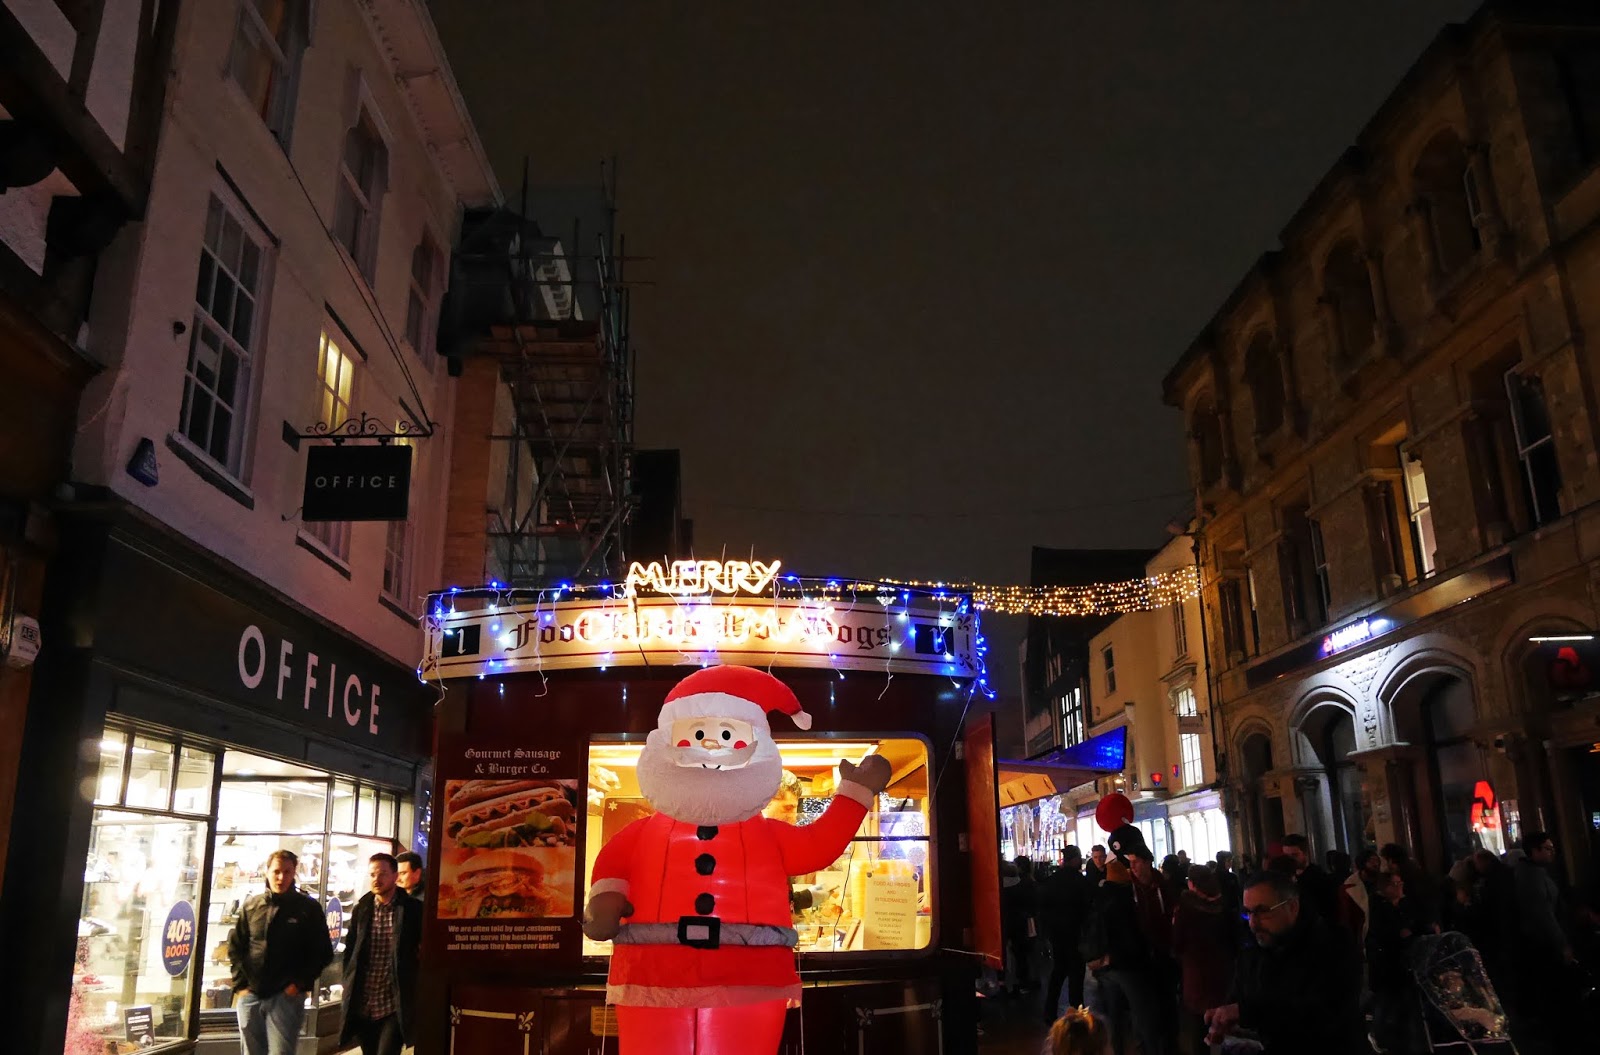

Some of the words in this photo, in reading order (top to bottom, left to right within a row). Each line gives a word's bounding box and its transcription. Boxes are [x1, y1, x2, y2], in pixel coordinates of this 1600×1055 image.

[315, 476, 396, 489] OFFICE
[627, 560, 781, 594] MERRY
[238, 624, 381, 735] OFFICE
[464, 748, 511, 759] Gourmet
[514, 748, 561, 760] Sausage
[475, 763, 485, 774] &
[488, 763, 528, 775] Burger
[531, 763, 550, 774] Co.
[504, 925, 513, 933] by
[455, 933, 468, 941] that
[527, 933, 554, 941] burgers
[165, 944, 190, 958] BOOTS
[473, 943, 489, 951] dogs
[490, 943, 504, 951] they
